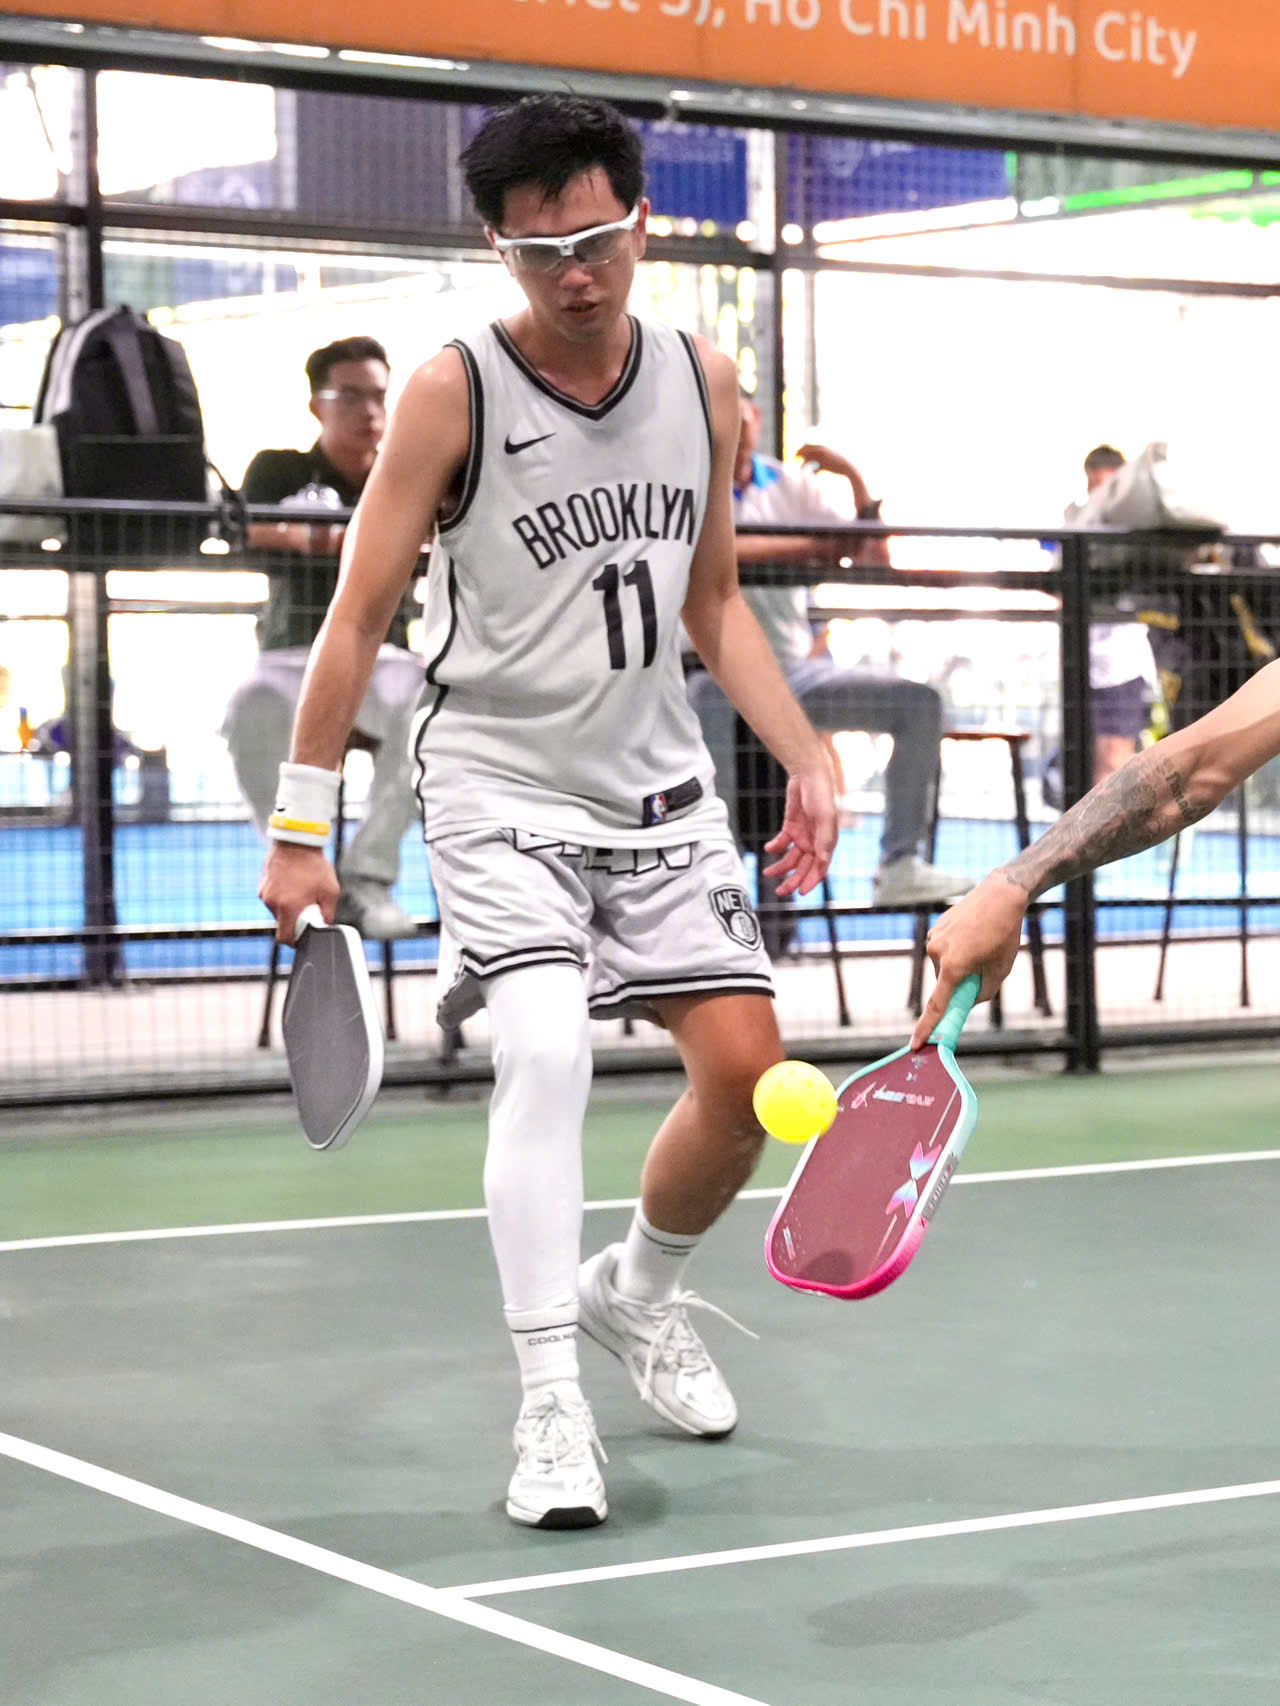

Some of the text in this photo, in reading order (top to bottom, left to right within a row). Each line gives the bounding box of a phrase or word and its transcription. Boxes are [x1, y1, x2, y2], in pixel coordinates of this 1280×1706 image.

[745, 0, 821, 31] Ho
[840, 0, 928, 41] Chi
[946, 0, 1077, 57] Minh
[1093, 11, 1198, 79] City
[511, 482, 697, 570] BROOKLYN
[592, 559, 659, 671] 11
